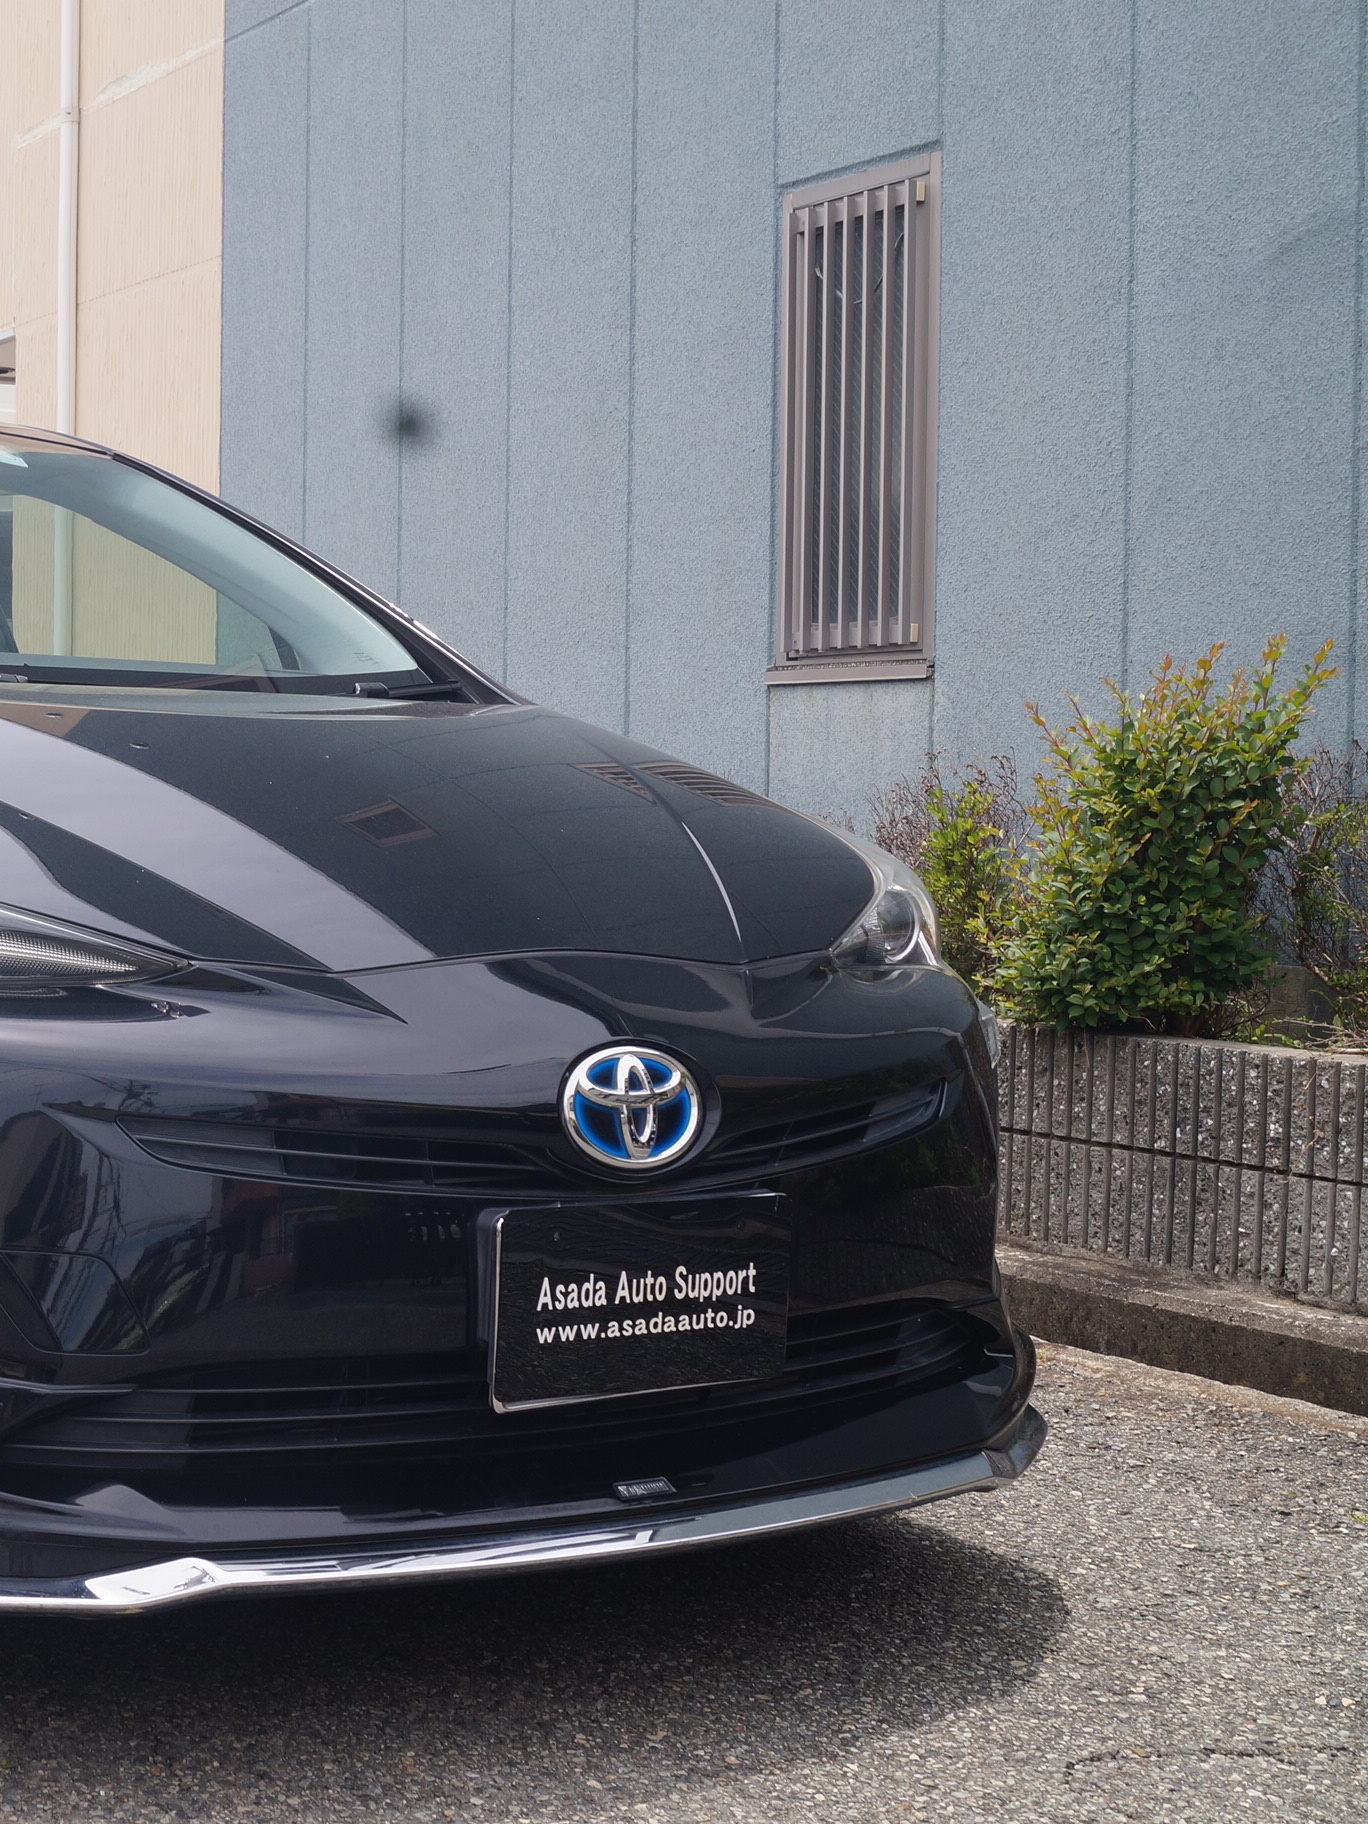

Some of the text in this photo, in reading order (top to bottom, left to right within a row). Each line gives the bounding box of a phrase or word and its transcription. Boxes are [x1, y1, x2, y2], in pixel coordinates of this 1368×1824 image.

[536, 1262, 757, 1311] Asada Auto Support
[536, 1304, 756, 1344] www.asadaauto.jp
